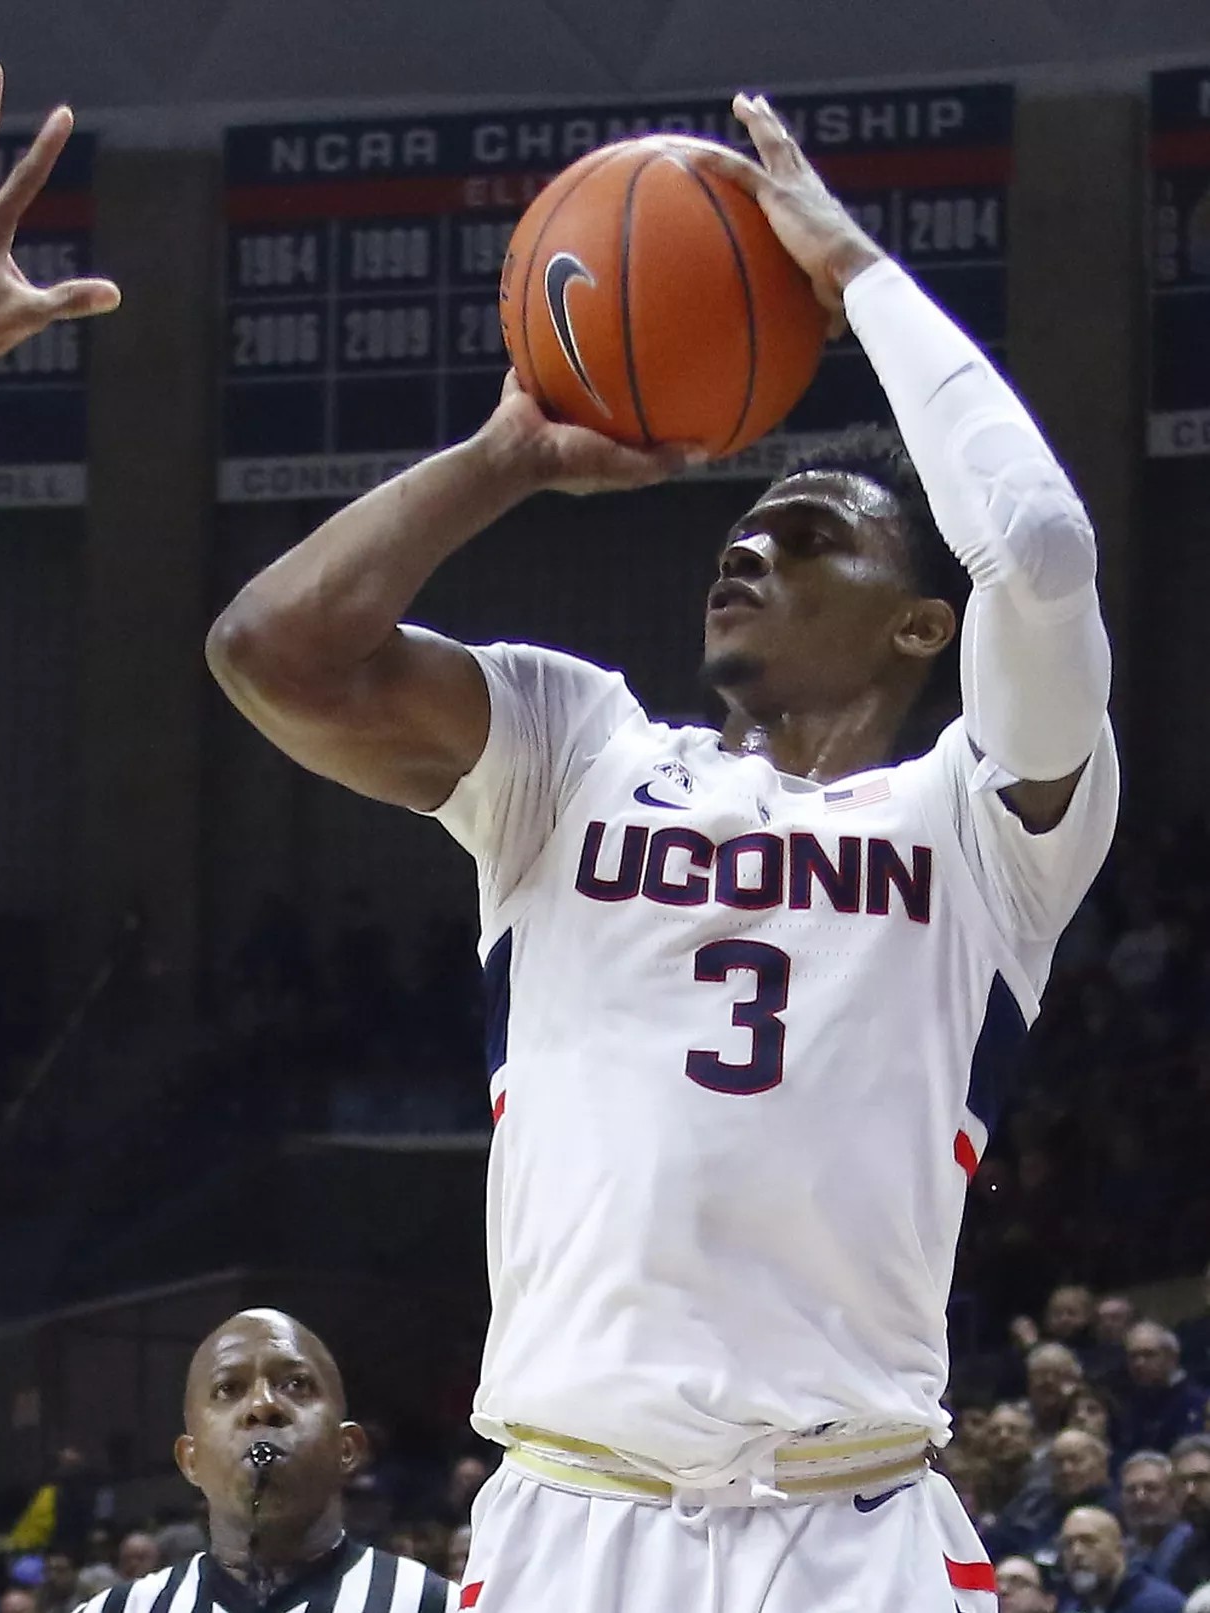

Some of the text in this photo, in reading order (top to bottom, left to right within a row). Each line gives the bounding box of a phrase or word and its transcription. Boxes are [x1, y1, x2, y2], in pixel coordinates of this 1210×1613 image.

[271, 129, 438, 173] NCAA
[575, 821, 932, 924] UCONN
[685, 938, 791, 1095] 3
